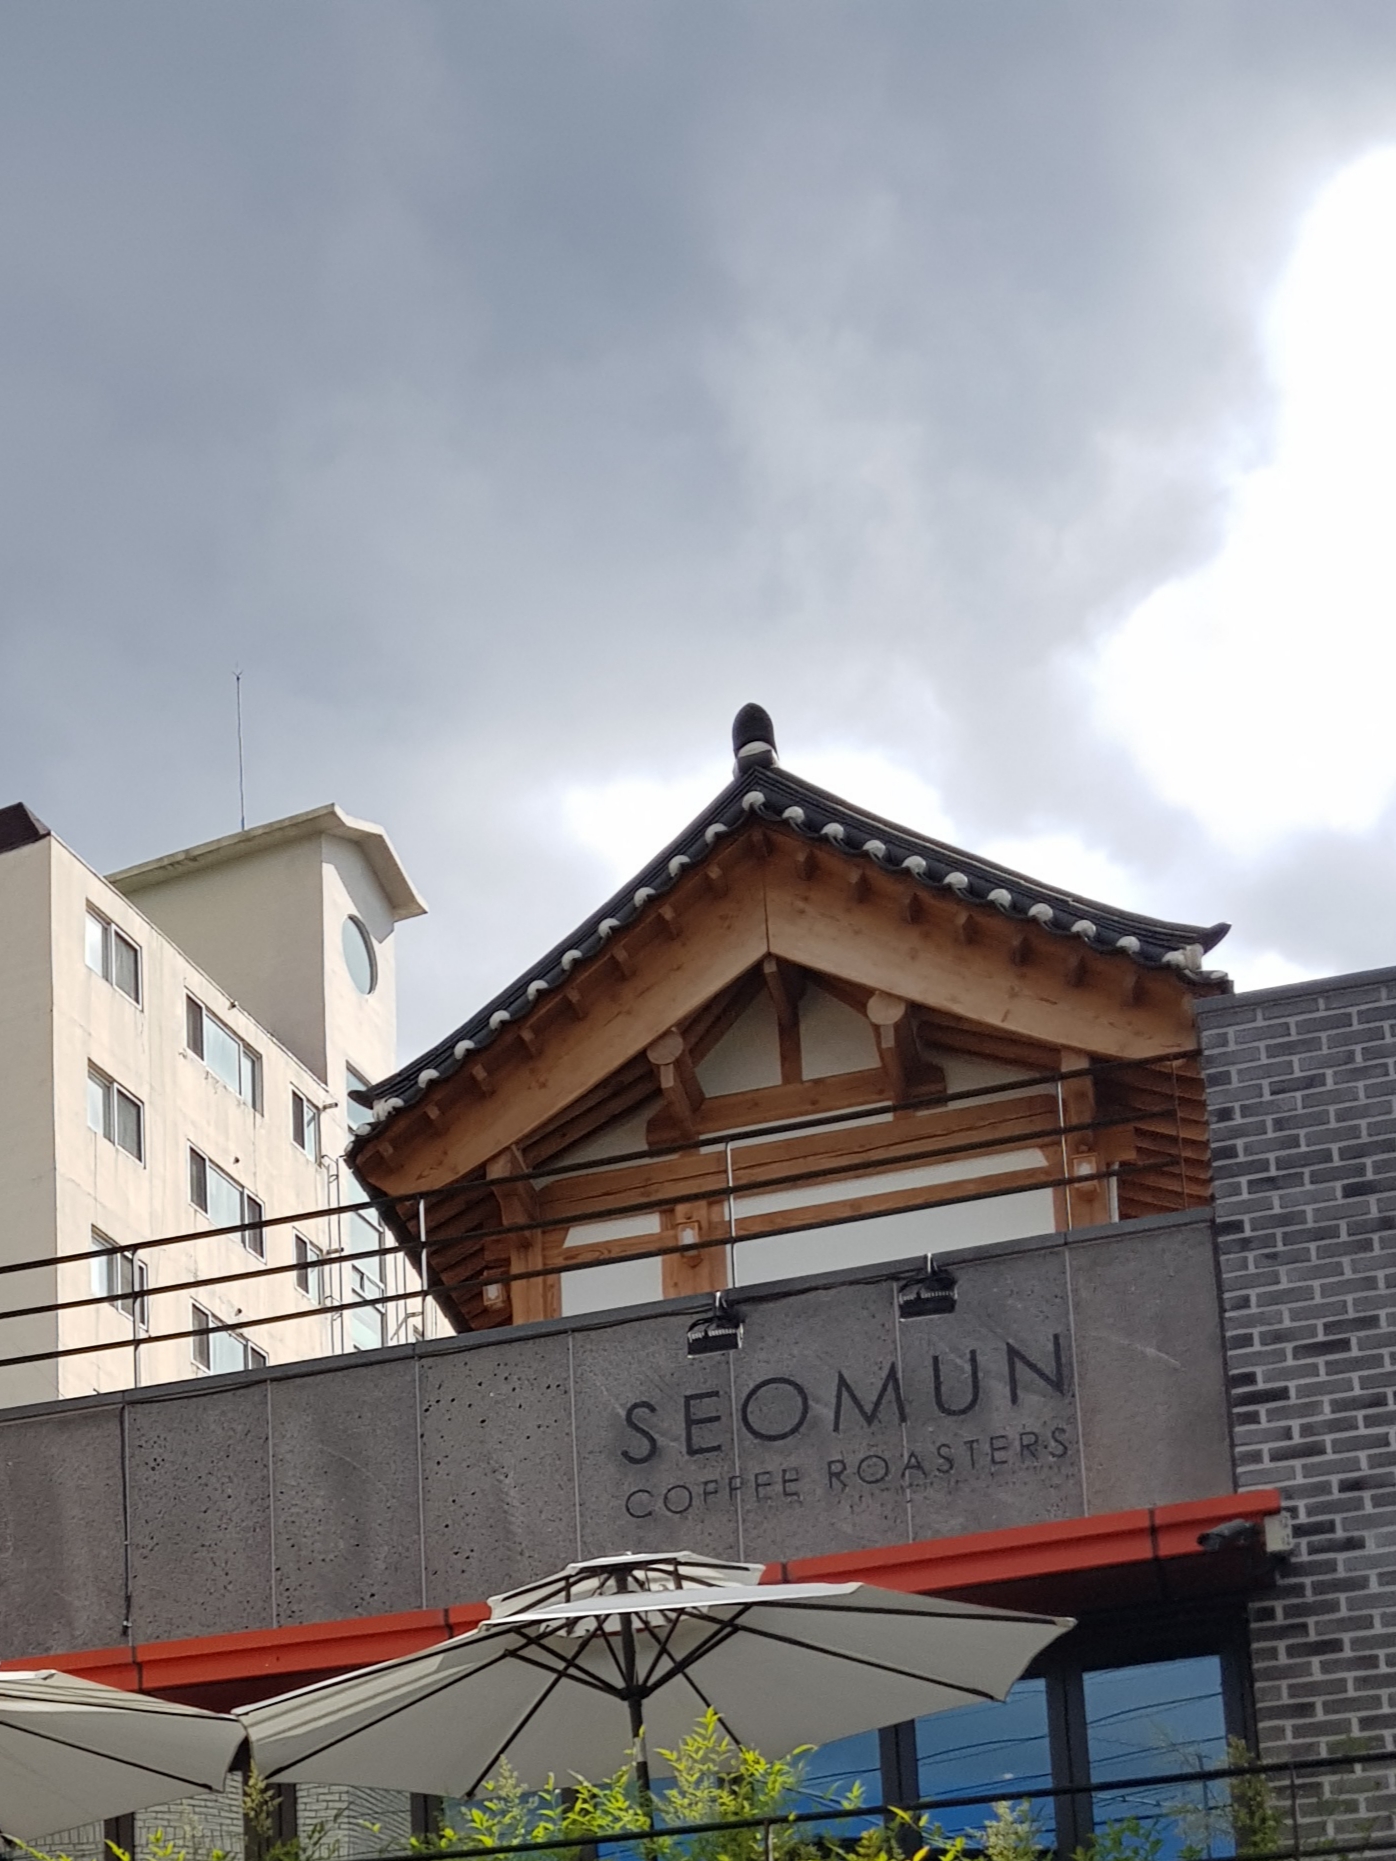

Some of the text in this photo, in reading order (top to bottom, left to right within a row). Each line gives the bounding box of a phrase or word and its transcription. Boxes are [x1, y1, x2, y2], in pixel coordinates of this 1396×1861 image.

[620, 1332, 1072, 1465] SEOMUN
[625, 1427, 1069, 1519] COFFEE ROASTERS
